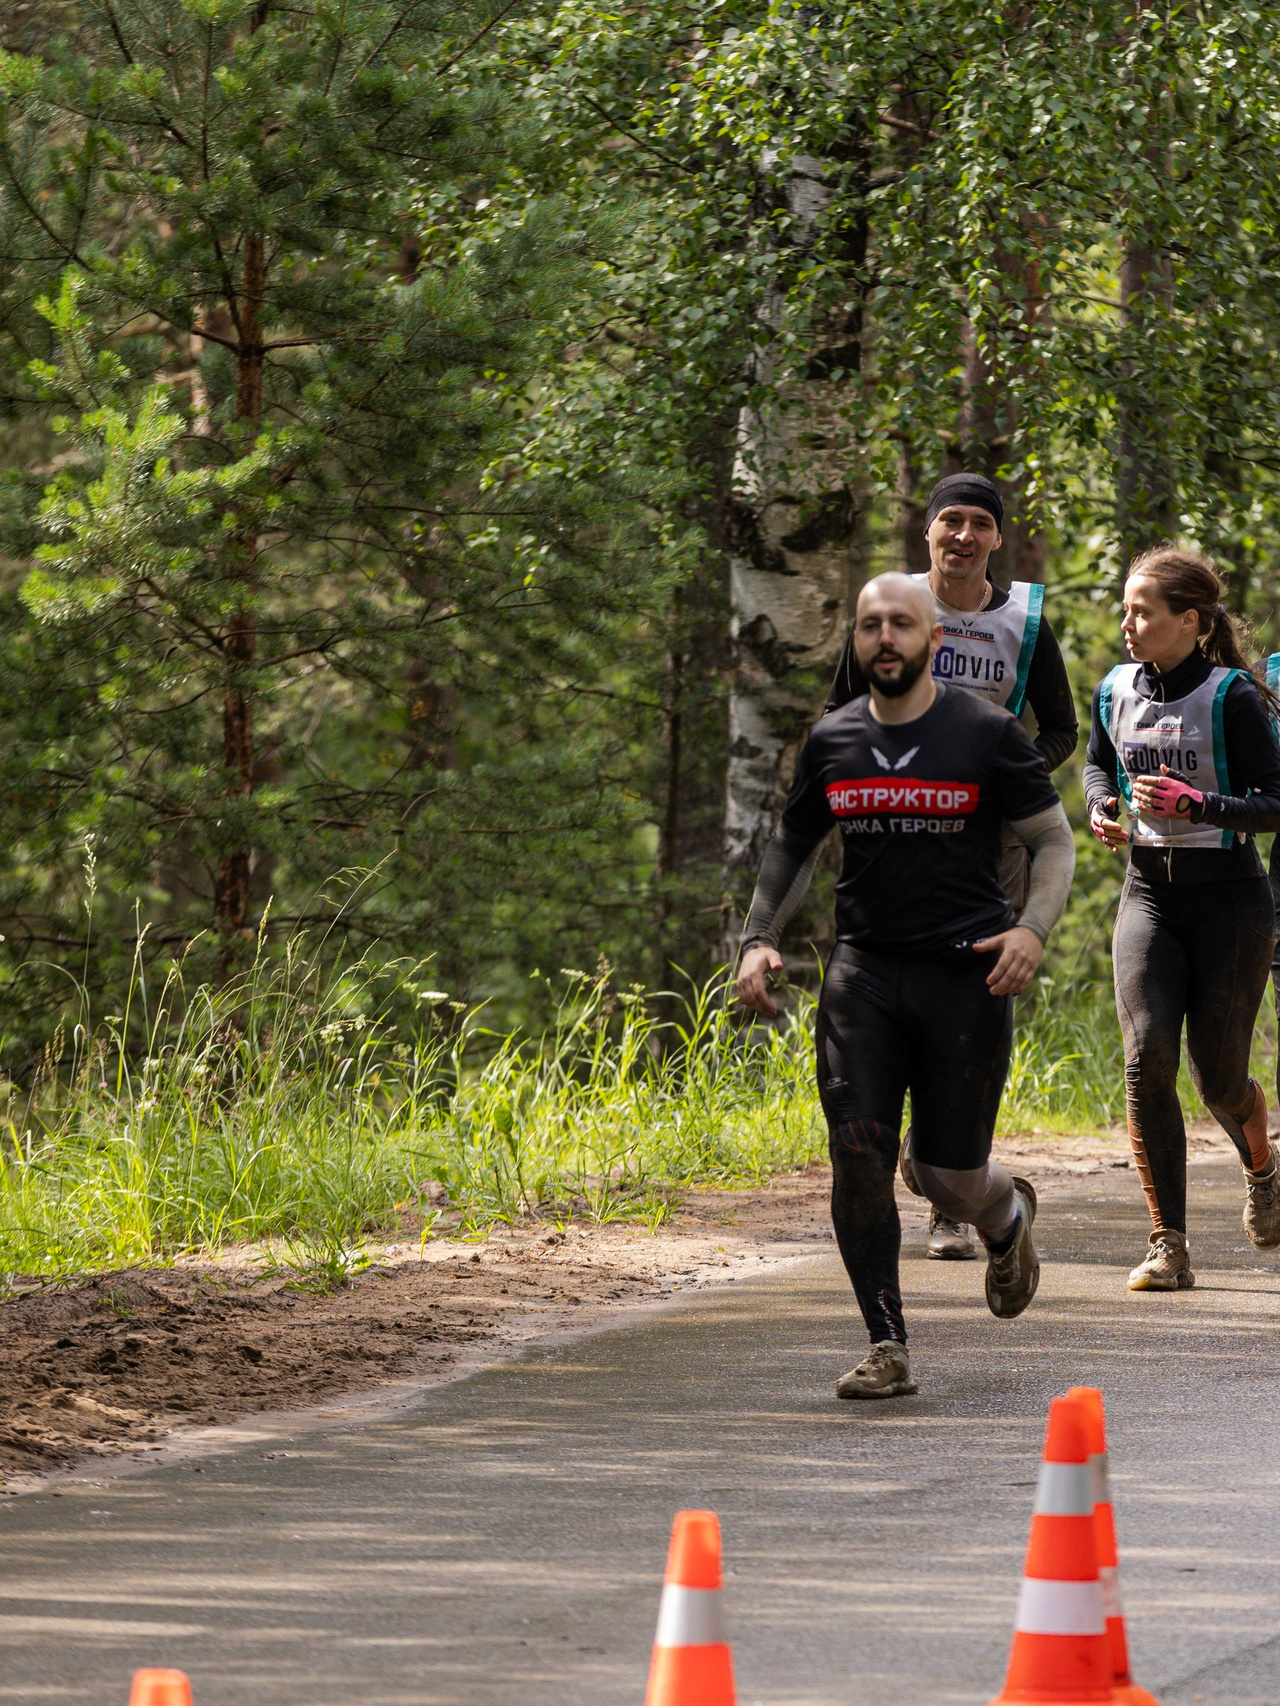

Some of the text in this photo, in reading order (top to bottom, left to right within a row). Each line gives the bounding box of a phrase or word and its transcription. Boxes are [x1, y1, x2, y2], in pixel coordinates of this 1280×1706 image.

[942, 626, 994, 640] ОНКА ГЕРОЕВ
[1124, 746, 1198, 771] RODVIG
[890, 818, 965, 834] ГЕРОЕВ
